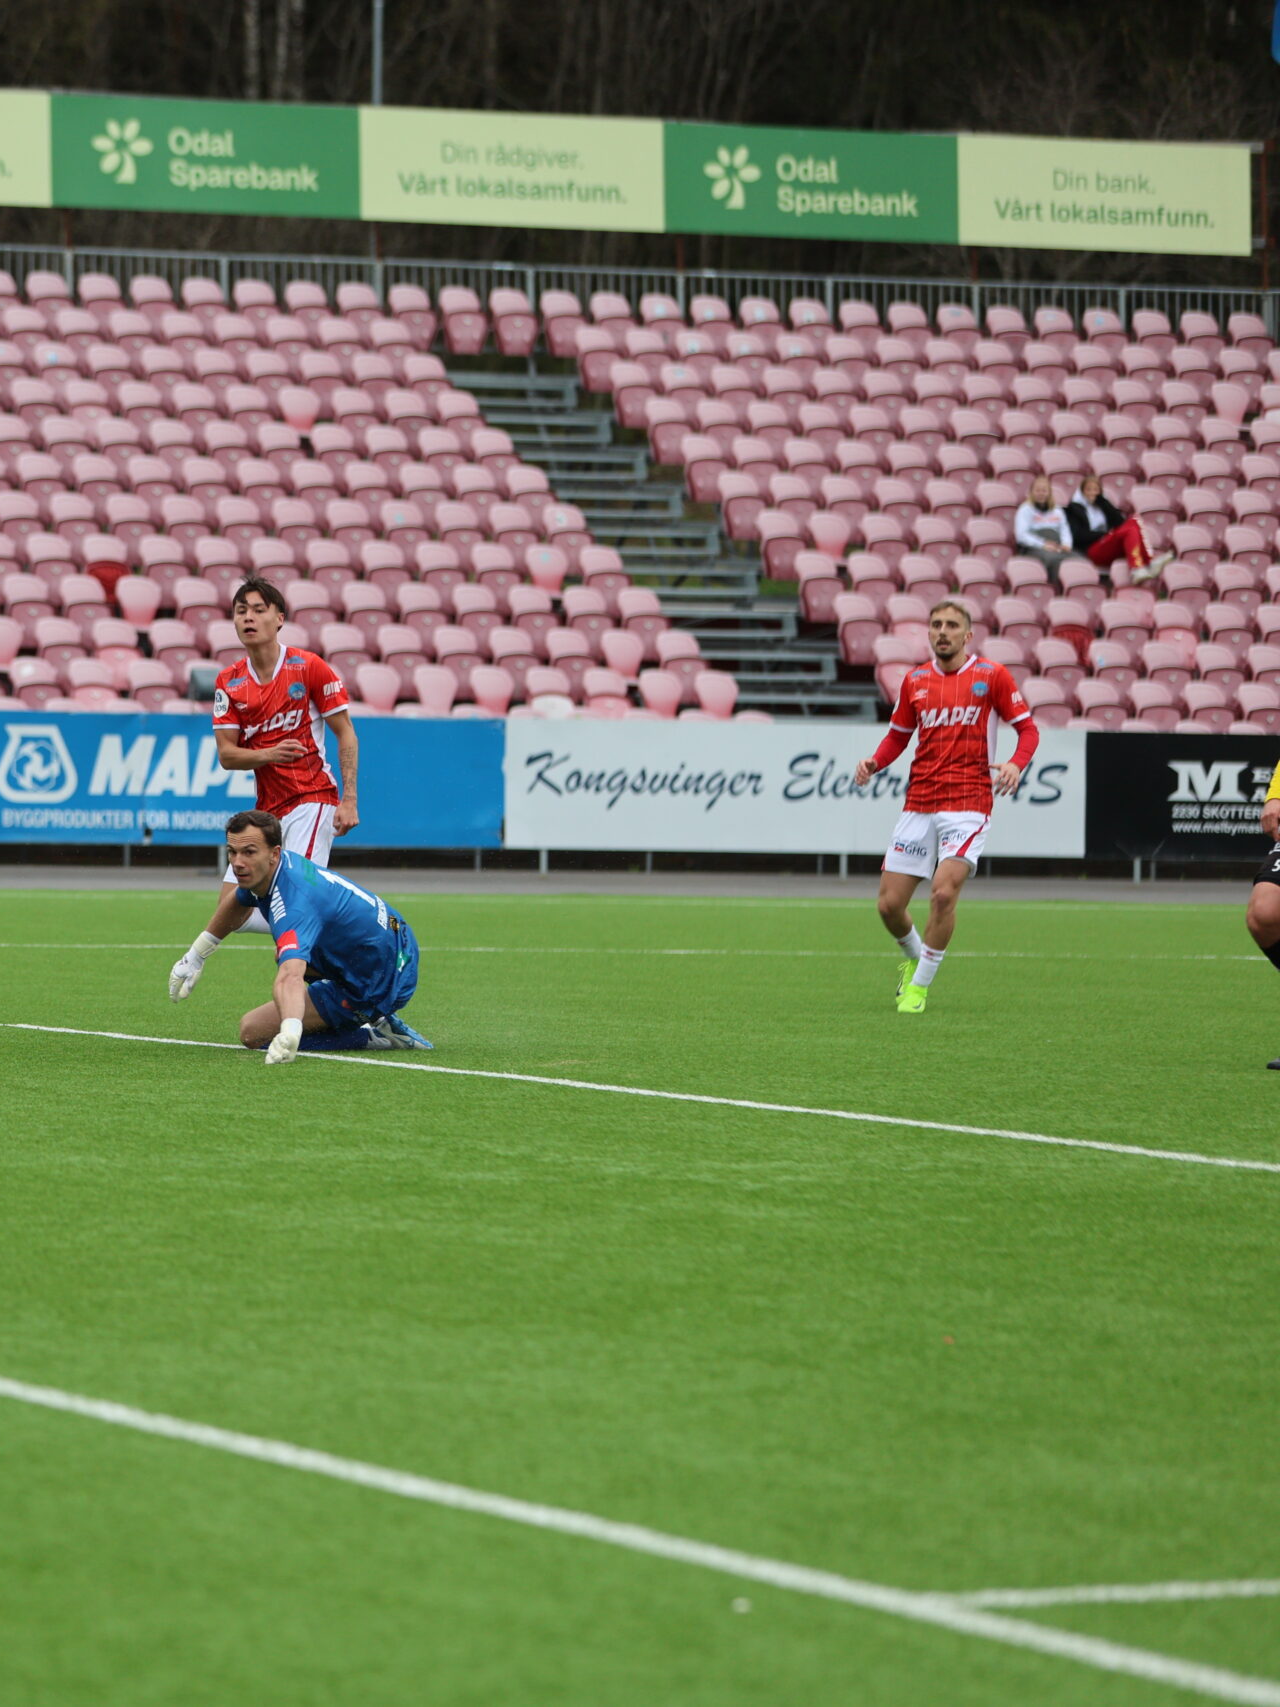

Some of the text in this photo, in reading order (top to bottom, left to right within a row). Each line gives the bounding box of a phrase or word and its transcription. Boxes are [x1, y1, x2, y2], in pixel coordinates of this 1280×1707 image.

[168, 126, 235, 157] Odal
[439, 140, 586, 171] Din rådgiver.
[169, 157, 319, 192] Sparebank
[776, 154, 839, 184] Odal
[1051, 169, 1157, 195] Din bank.
[397, 170, 628, 205] Vårt lokalsamfunn.
[777, 184, 919, 217] Sparebank
[994, 198, 1216, 229] Vårt lokalsamfunn.
[921, 706, 981, 728] MAPEI
[524, 753, 764, 811] Kongsvinger
[1, 808, 133, 829] BYGGPRODUKTER
[172, 810, 230, 831] NORDIS
[1172, 804, 1262, 820] 2230 SKOTTER
[905, 845, 928, 857] GHG
